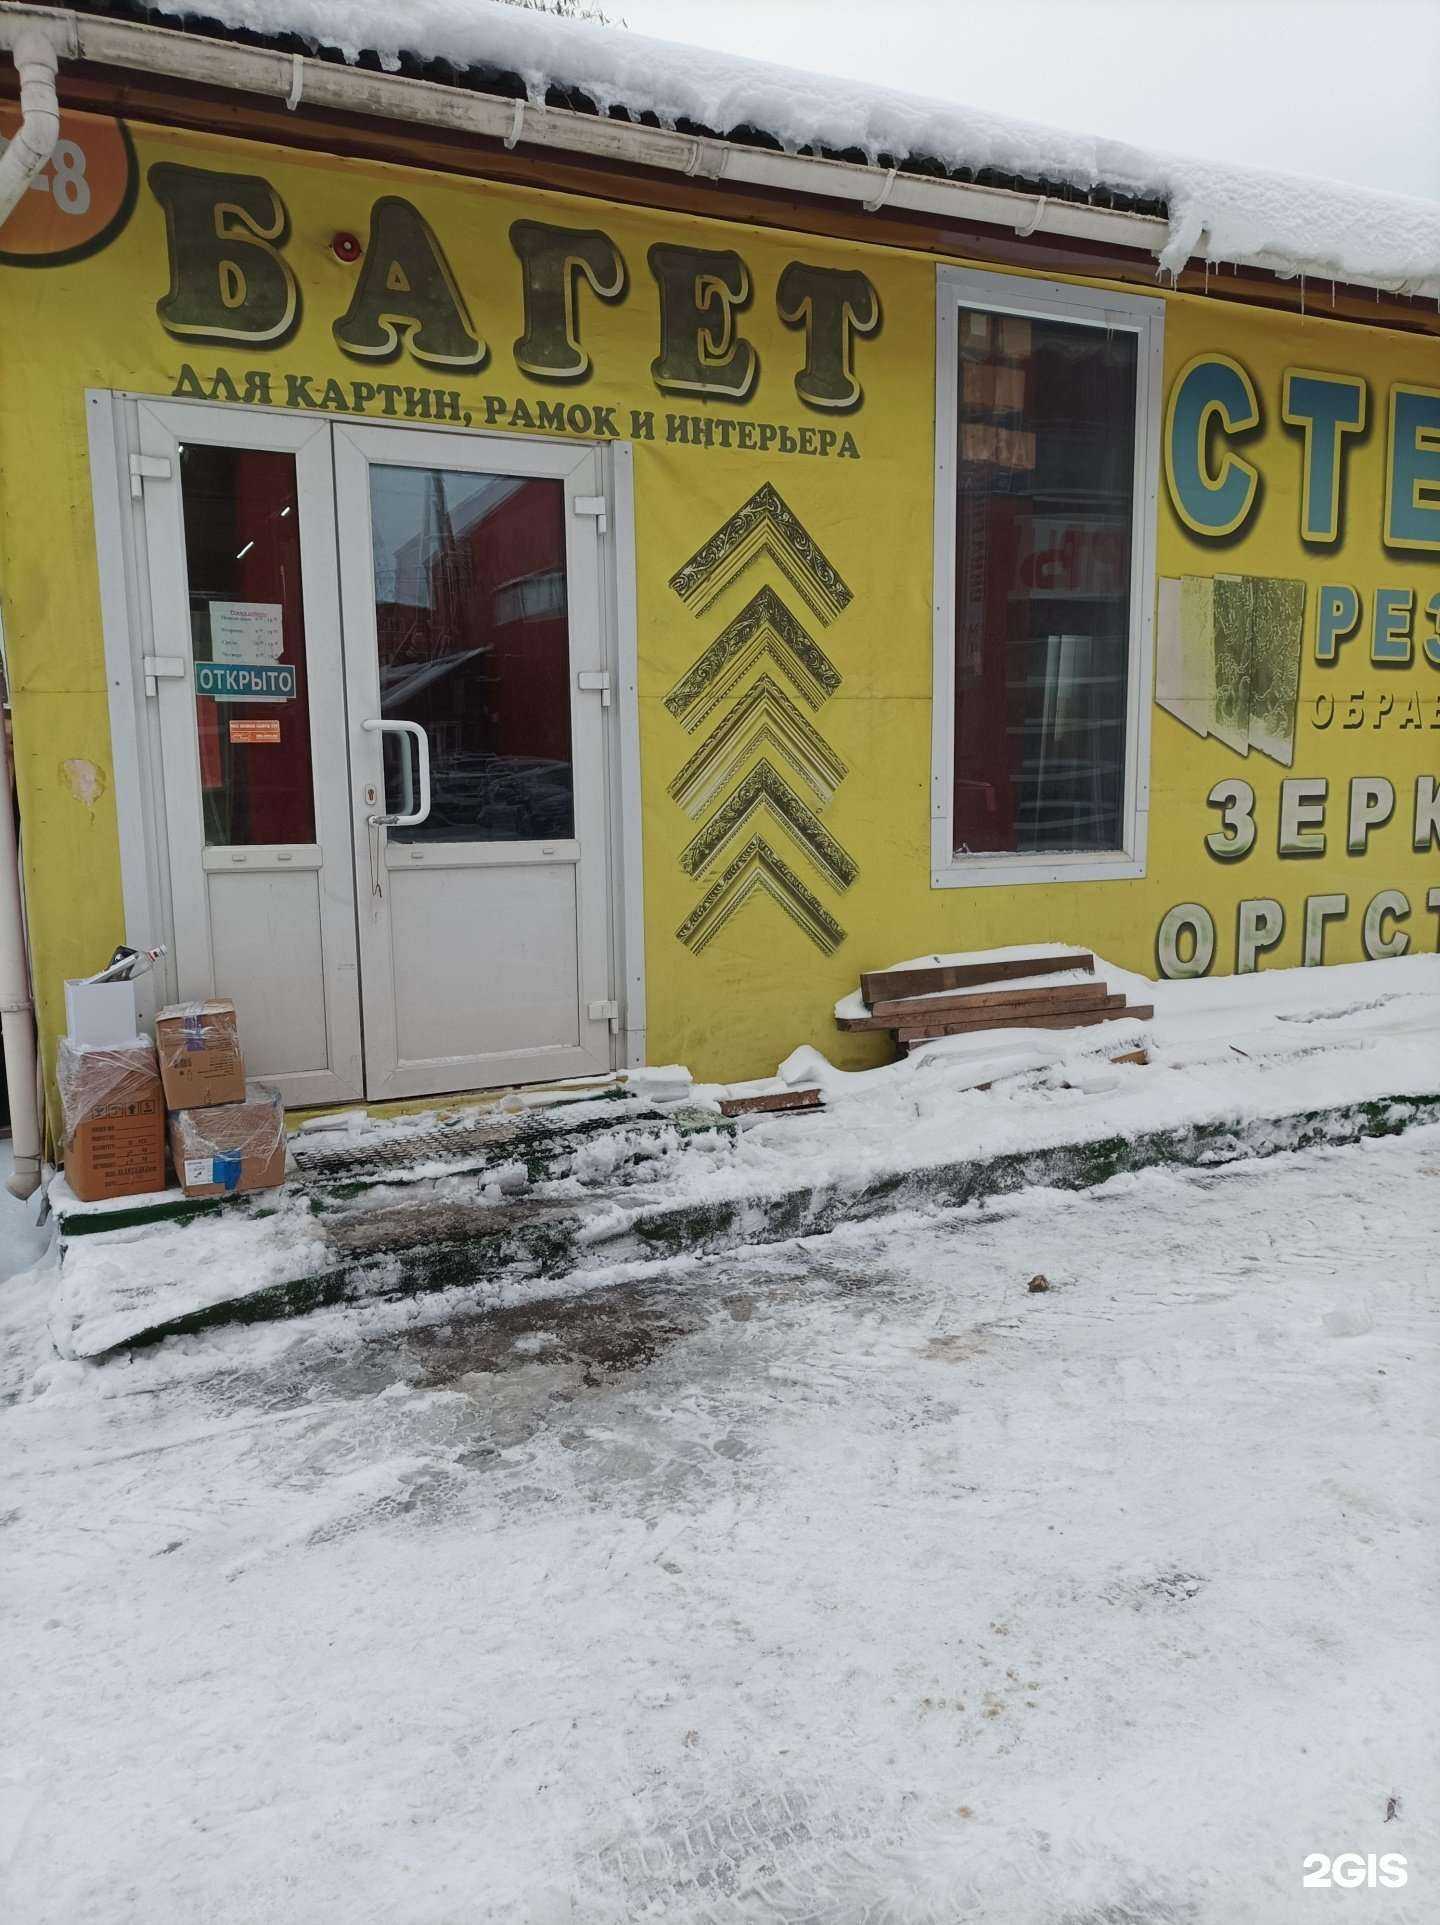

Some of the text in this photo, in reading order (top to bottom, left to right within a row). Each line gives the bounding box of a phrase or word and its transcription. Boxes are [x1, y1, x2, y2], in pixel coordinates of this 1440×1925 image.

[147, 161, 881, 413] БАГЕТ
[172, 364, 861, 459] ДЛЯ КАРТИН, РАМОК И ИНТЕРЬЕРА
[1164, 352, 1440, 554] СТЕ
[200, 669, 292, 692] ОТКРЫТО
